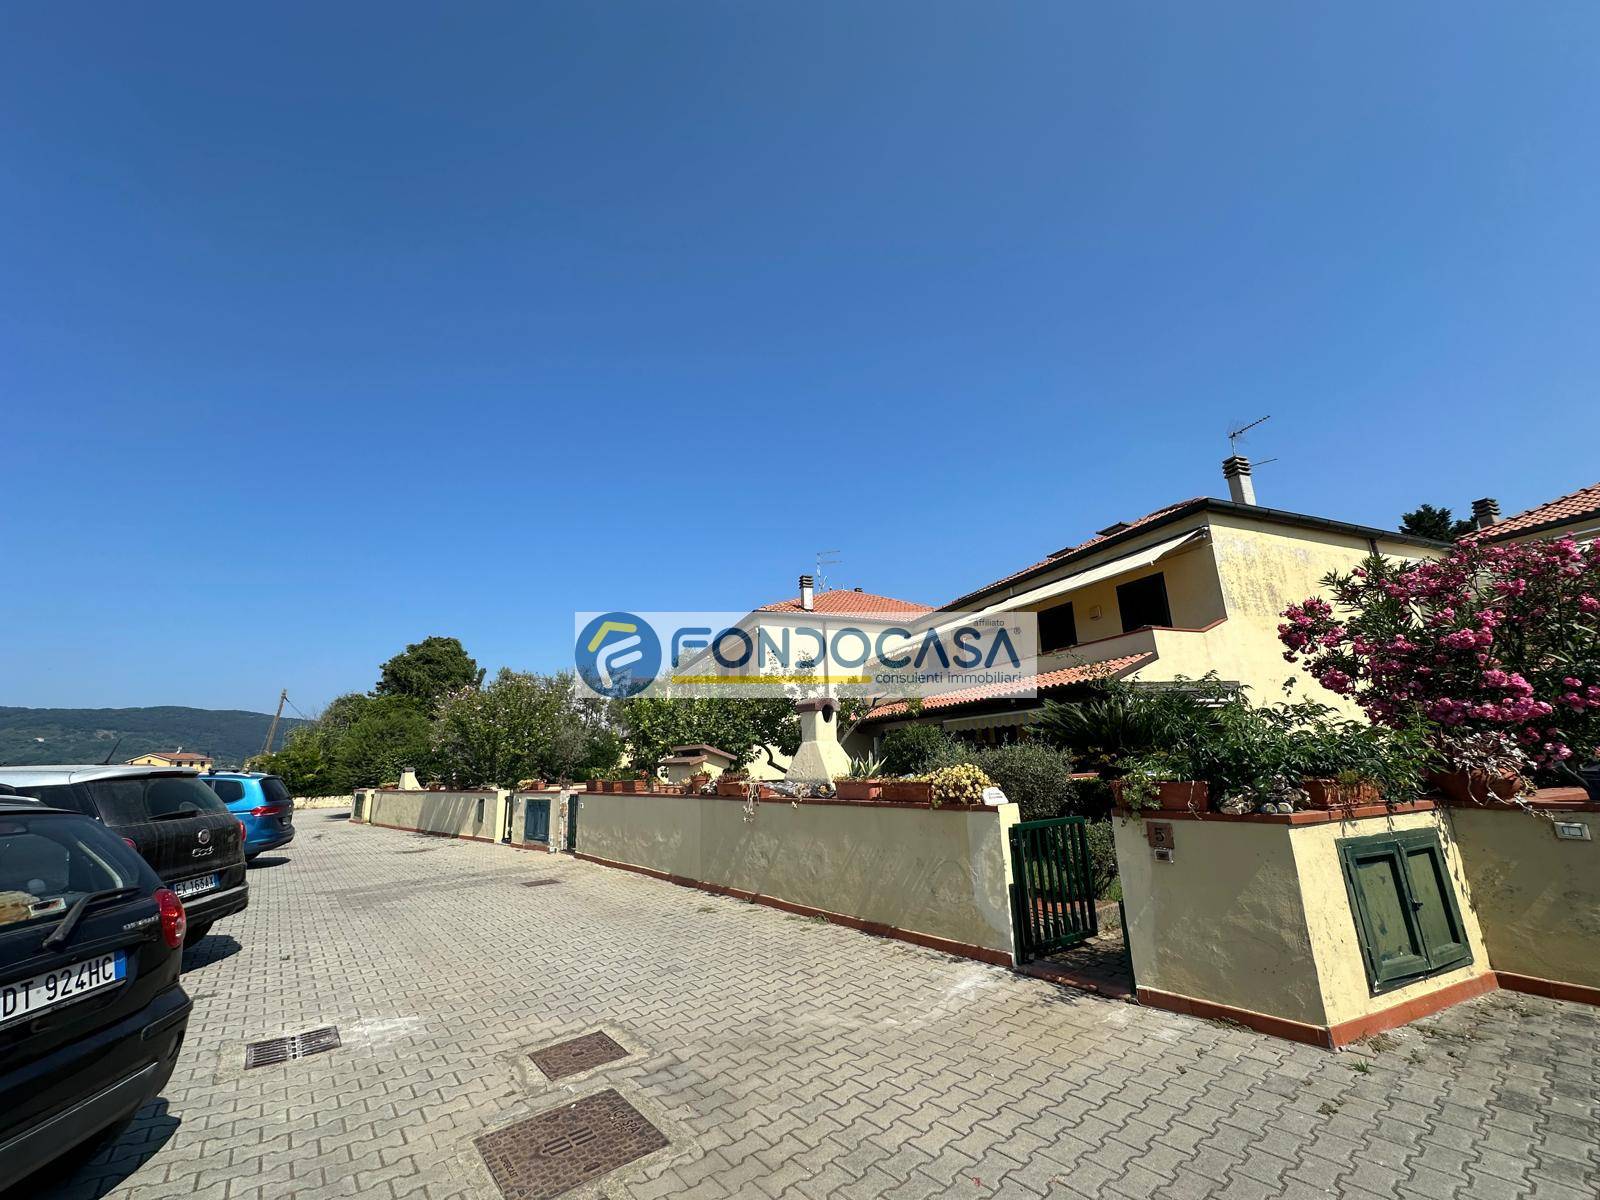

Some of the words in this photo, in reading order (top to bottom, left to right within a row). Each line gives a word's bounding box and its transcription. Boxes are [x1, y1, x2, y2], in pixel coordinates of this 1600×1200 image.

[1154, 827, 1165, 842] 5
[2, 980, 34, 1018] DT
[45, 956, 113, 1001] 924HC
